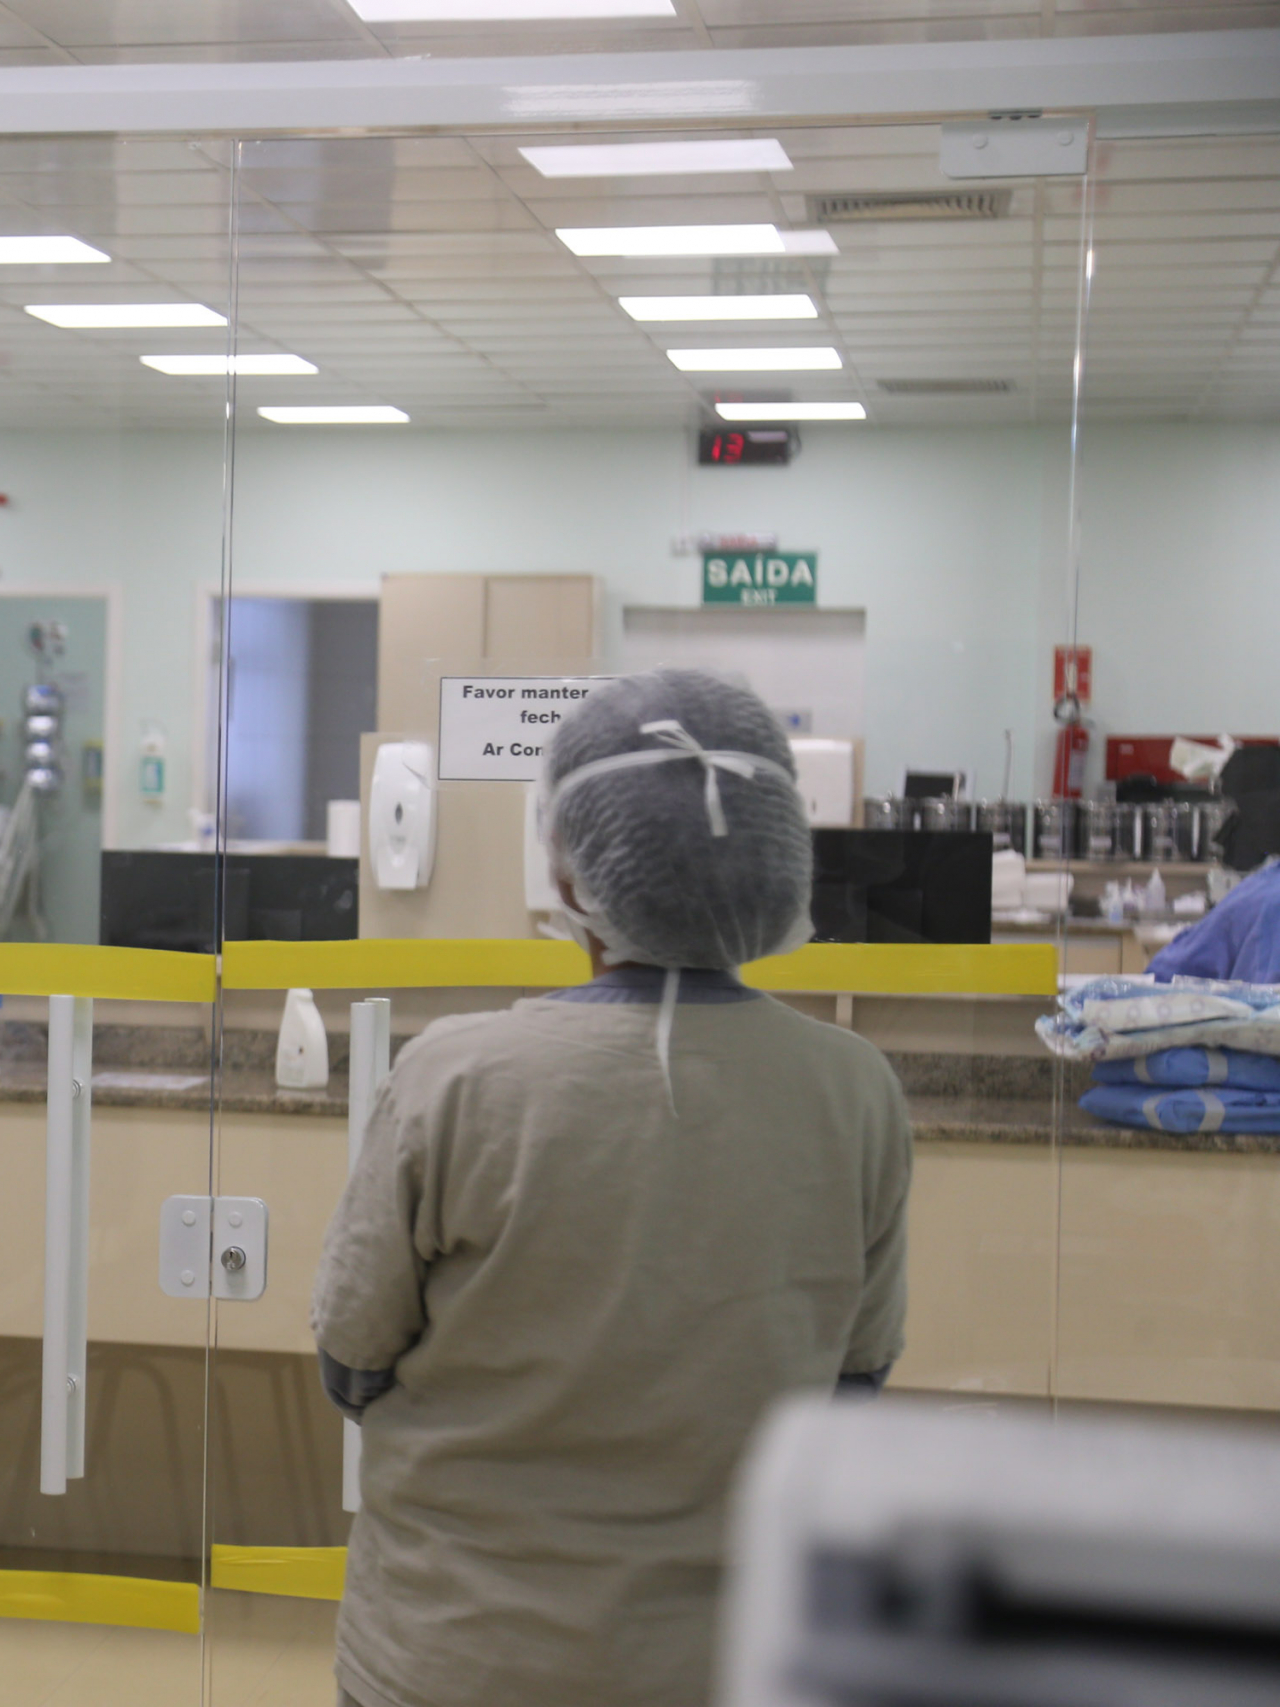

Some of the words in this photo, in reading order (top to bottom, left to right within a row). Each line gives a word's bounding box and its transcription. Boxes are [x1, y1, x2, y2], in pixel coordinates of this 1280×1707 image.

[707, 553, 814, 587] SAÍDA
[462, 685, 515, 700] Favor
[521, 686, 589, 700] manter
[482, 742, 504, 756] Ar
